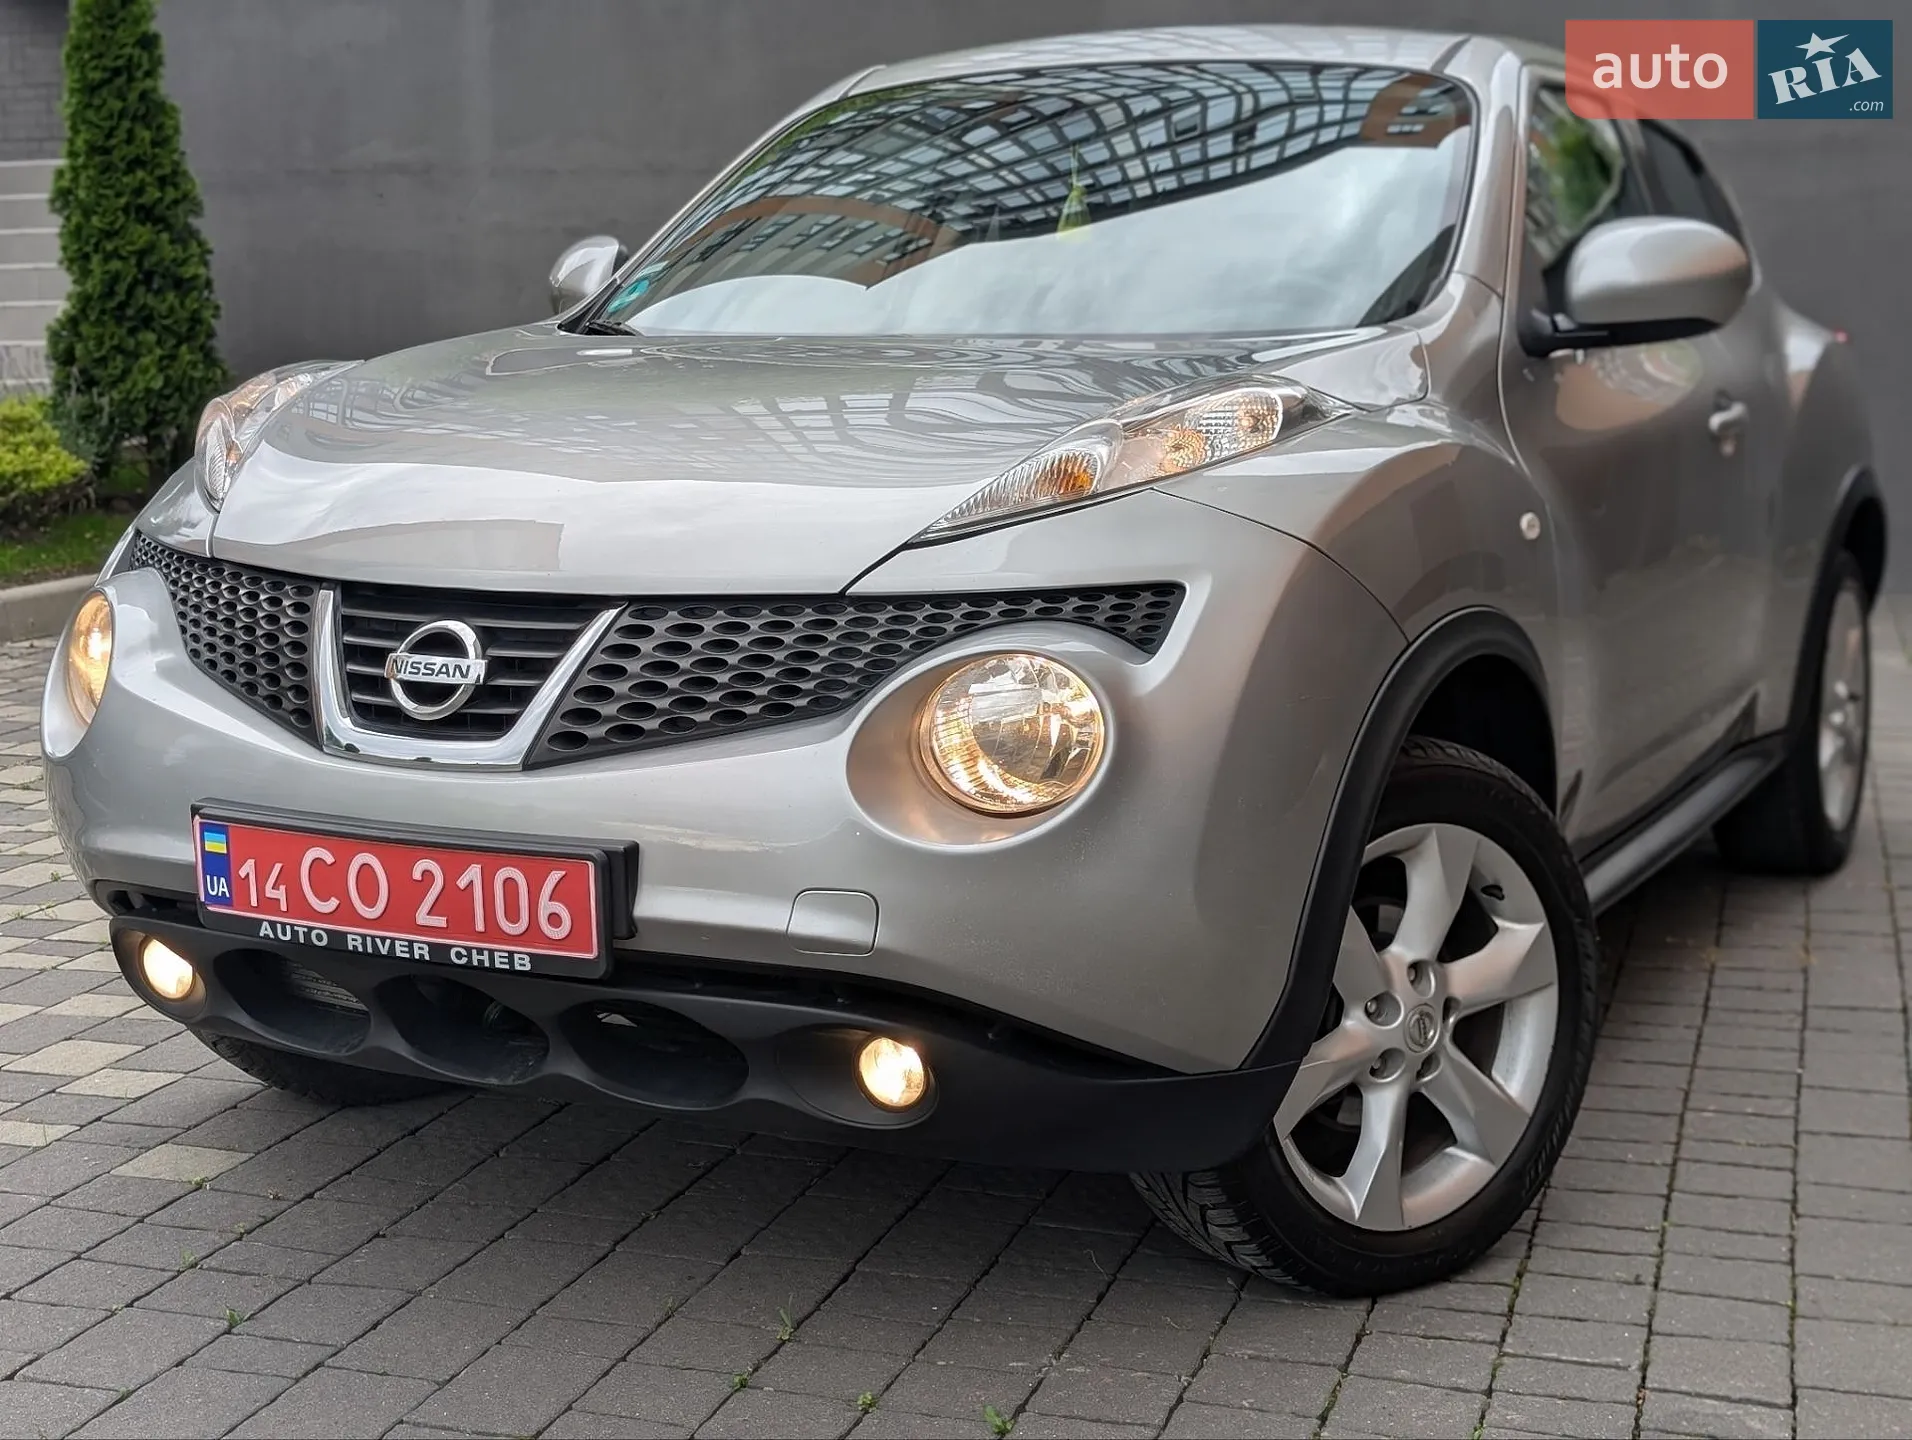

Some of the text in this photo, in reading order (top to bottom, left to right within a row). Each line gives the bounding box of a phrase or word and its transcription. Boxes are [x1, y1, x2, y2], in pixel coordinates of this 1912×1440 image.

[392, 658, 471, 679] NISSAN
[206, 875, 230, 898] UA
[412, 858, 572, 940] 2106
[259, 921, 532, 971] AUTO RIVER CHEB
